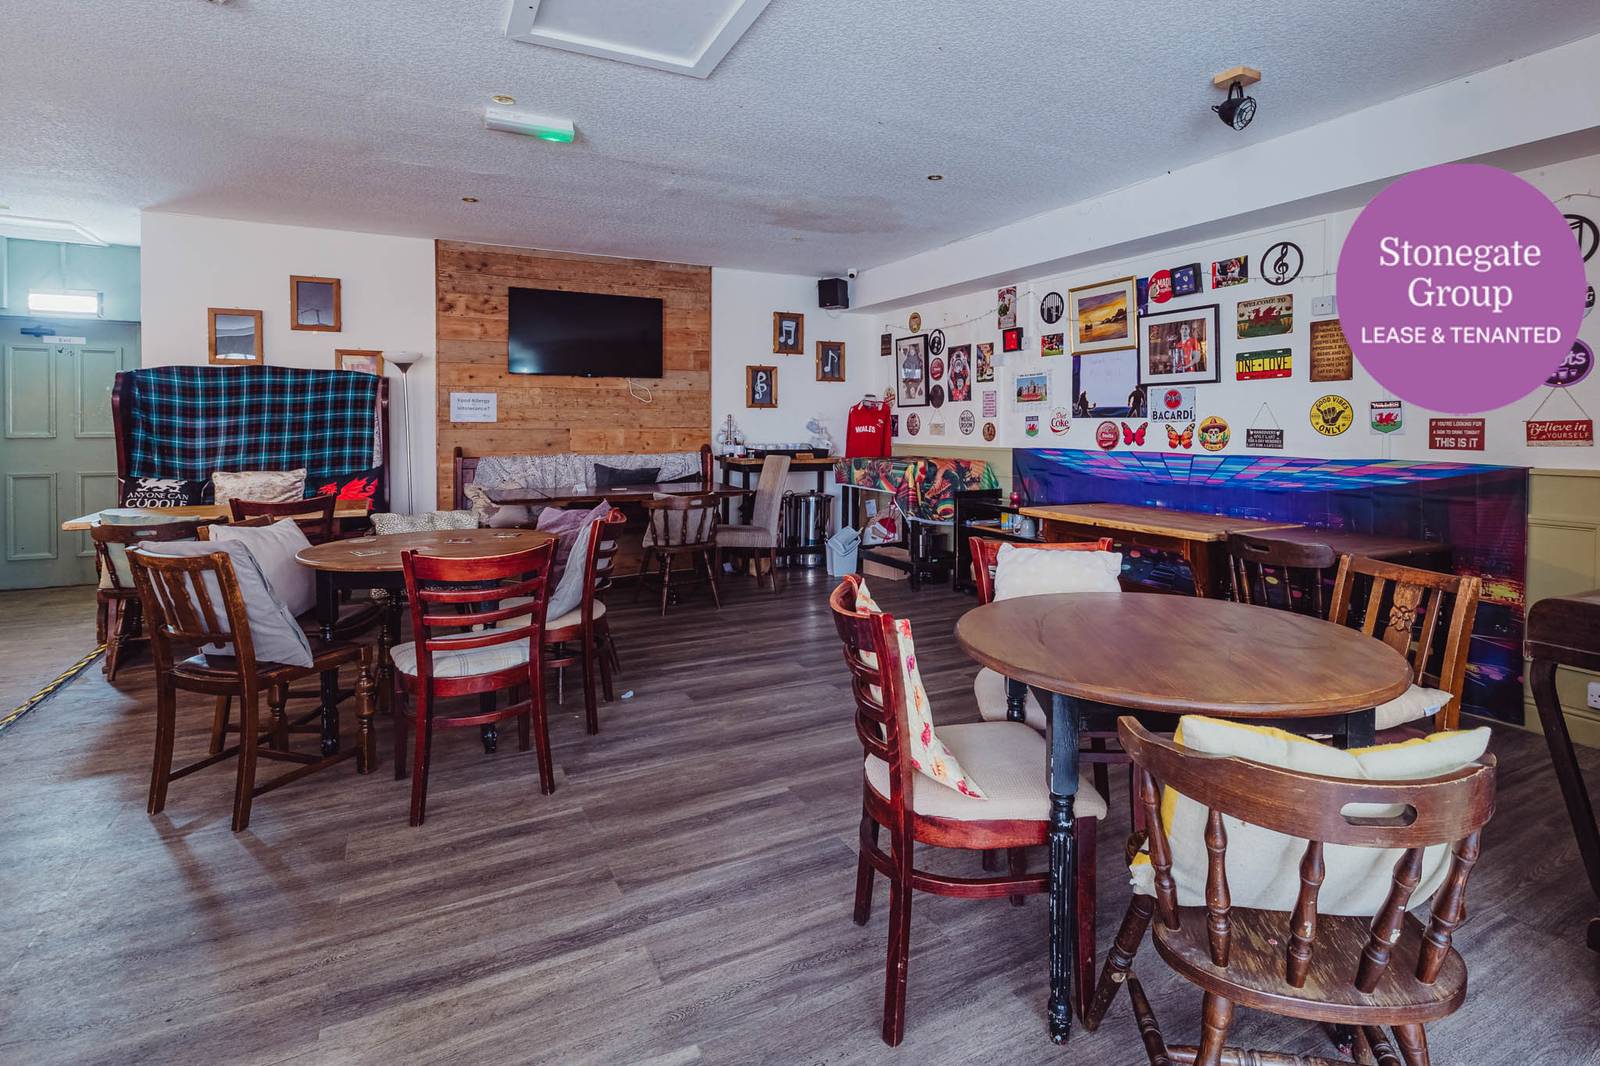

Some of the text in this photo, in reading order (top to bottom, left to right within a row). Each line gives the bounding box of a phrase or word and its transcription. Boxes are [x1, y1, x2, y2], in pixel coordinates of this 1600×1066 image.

[1316, 396, 1349, 410] GOOD VIBES
[1152, 406, 1193, 420] BACARDÍ
[1050, 417, 1069, 427] Coke
[854, 425, 876, 434] WALES
[1318, 425, 1341, 434] ONLY
[1528, 422, 1587, 436] Believe in
[1434, 437, 1479, 448] THIS IS IT
[127, 491, 166, 500] ANYONE
